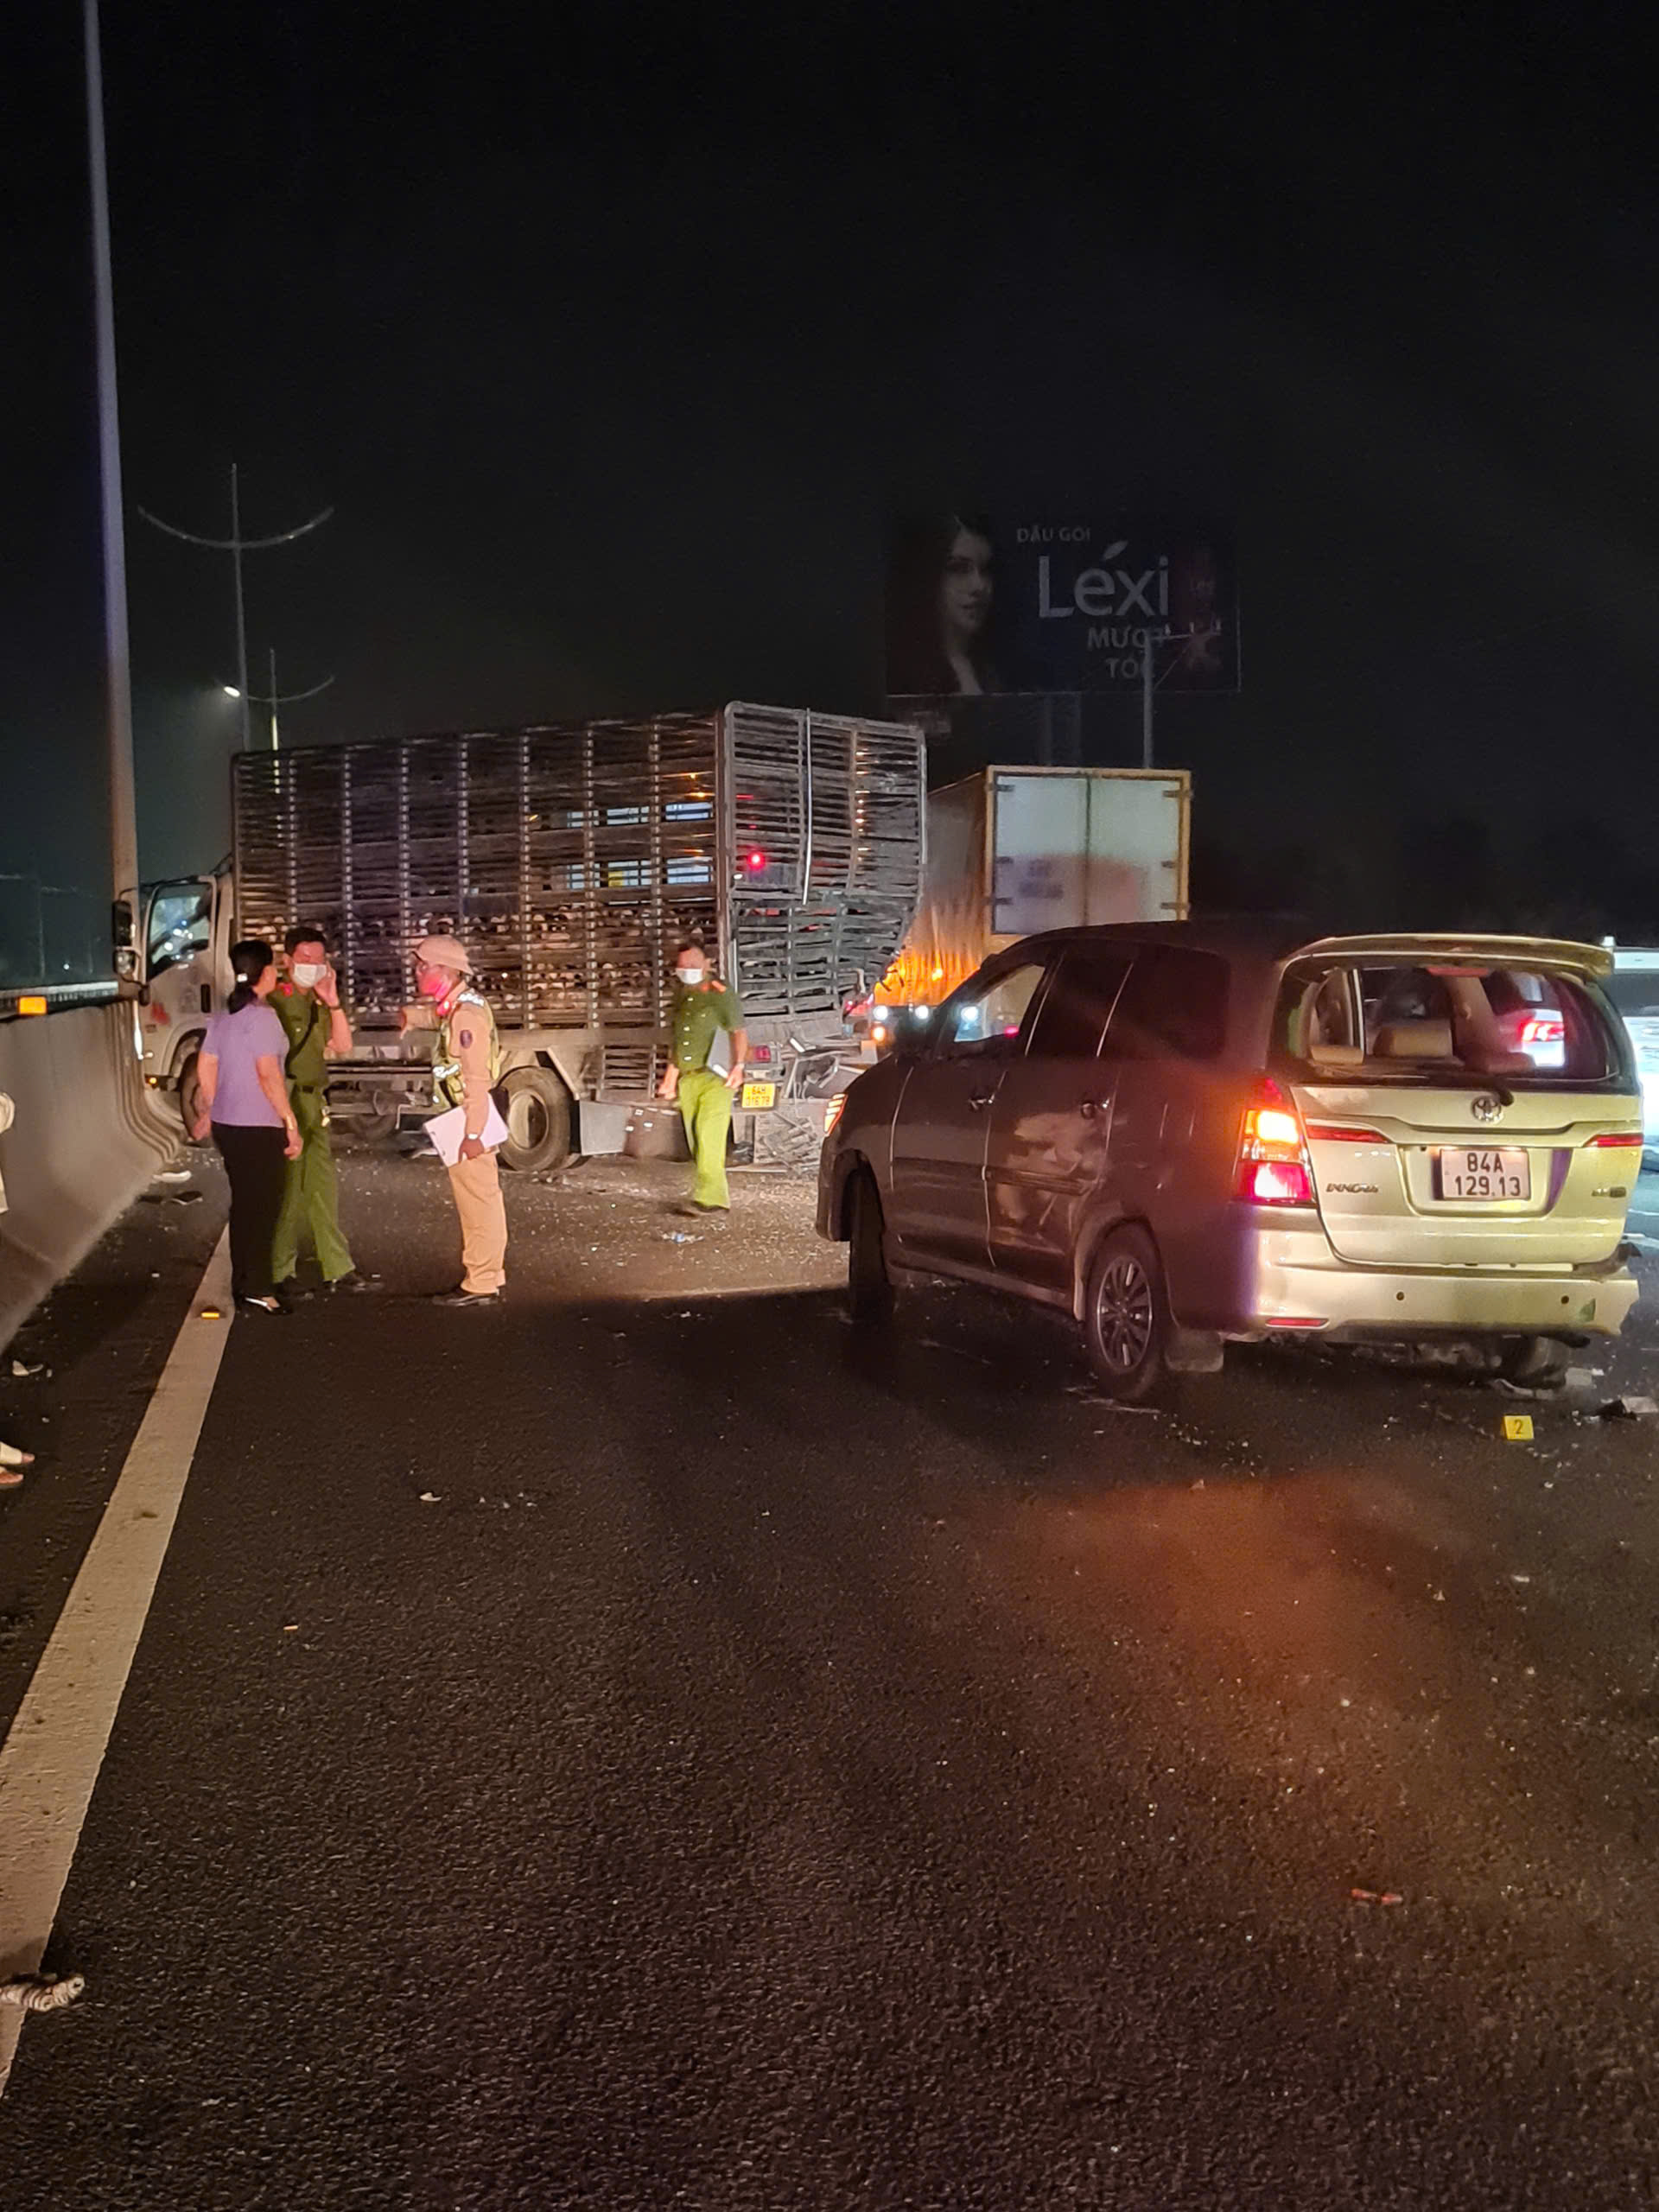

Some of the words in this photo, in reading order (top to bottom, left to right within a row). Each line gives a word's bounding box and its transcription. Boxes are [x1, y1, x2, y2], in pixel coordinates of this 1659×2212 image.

[1466, 1152, 1503, 1173] 84A
[1453, 1175, 1521, 1197] 129.13
[1513, 1419, 1523, 1435] 2
